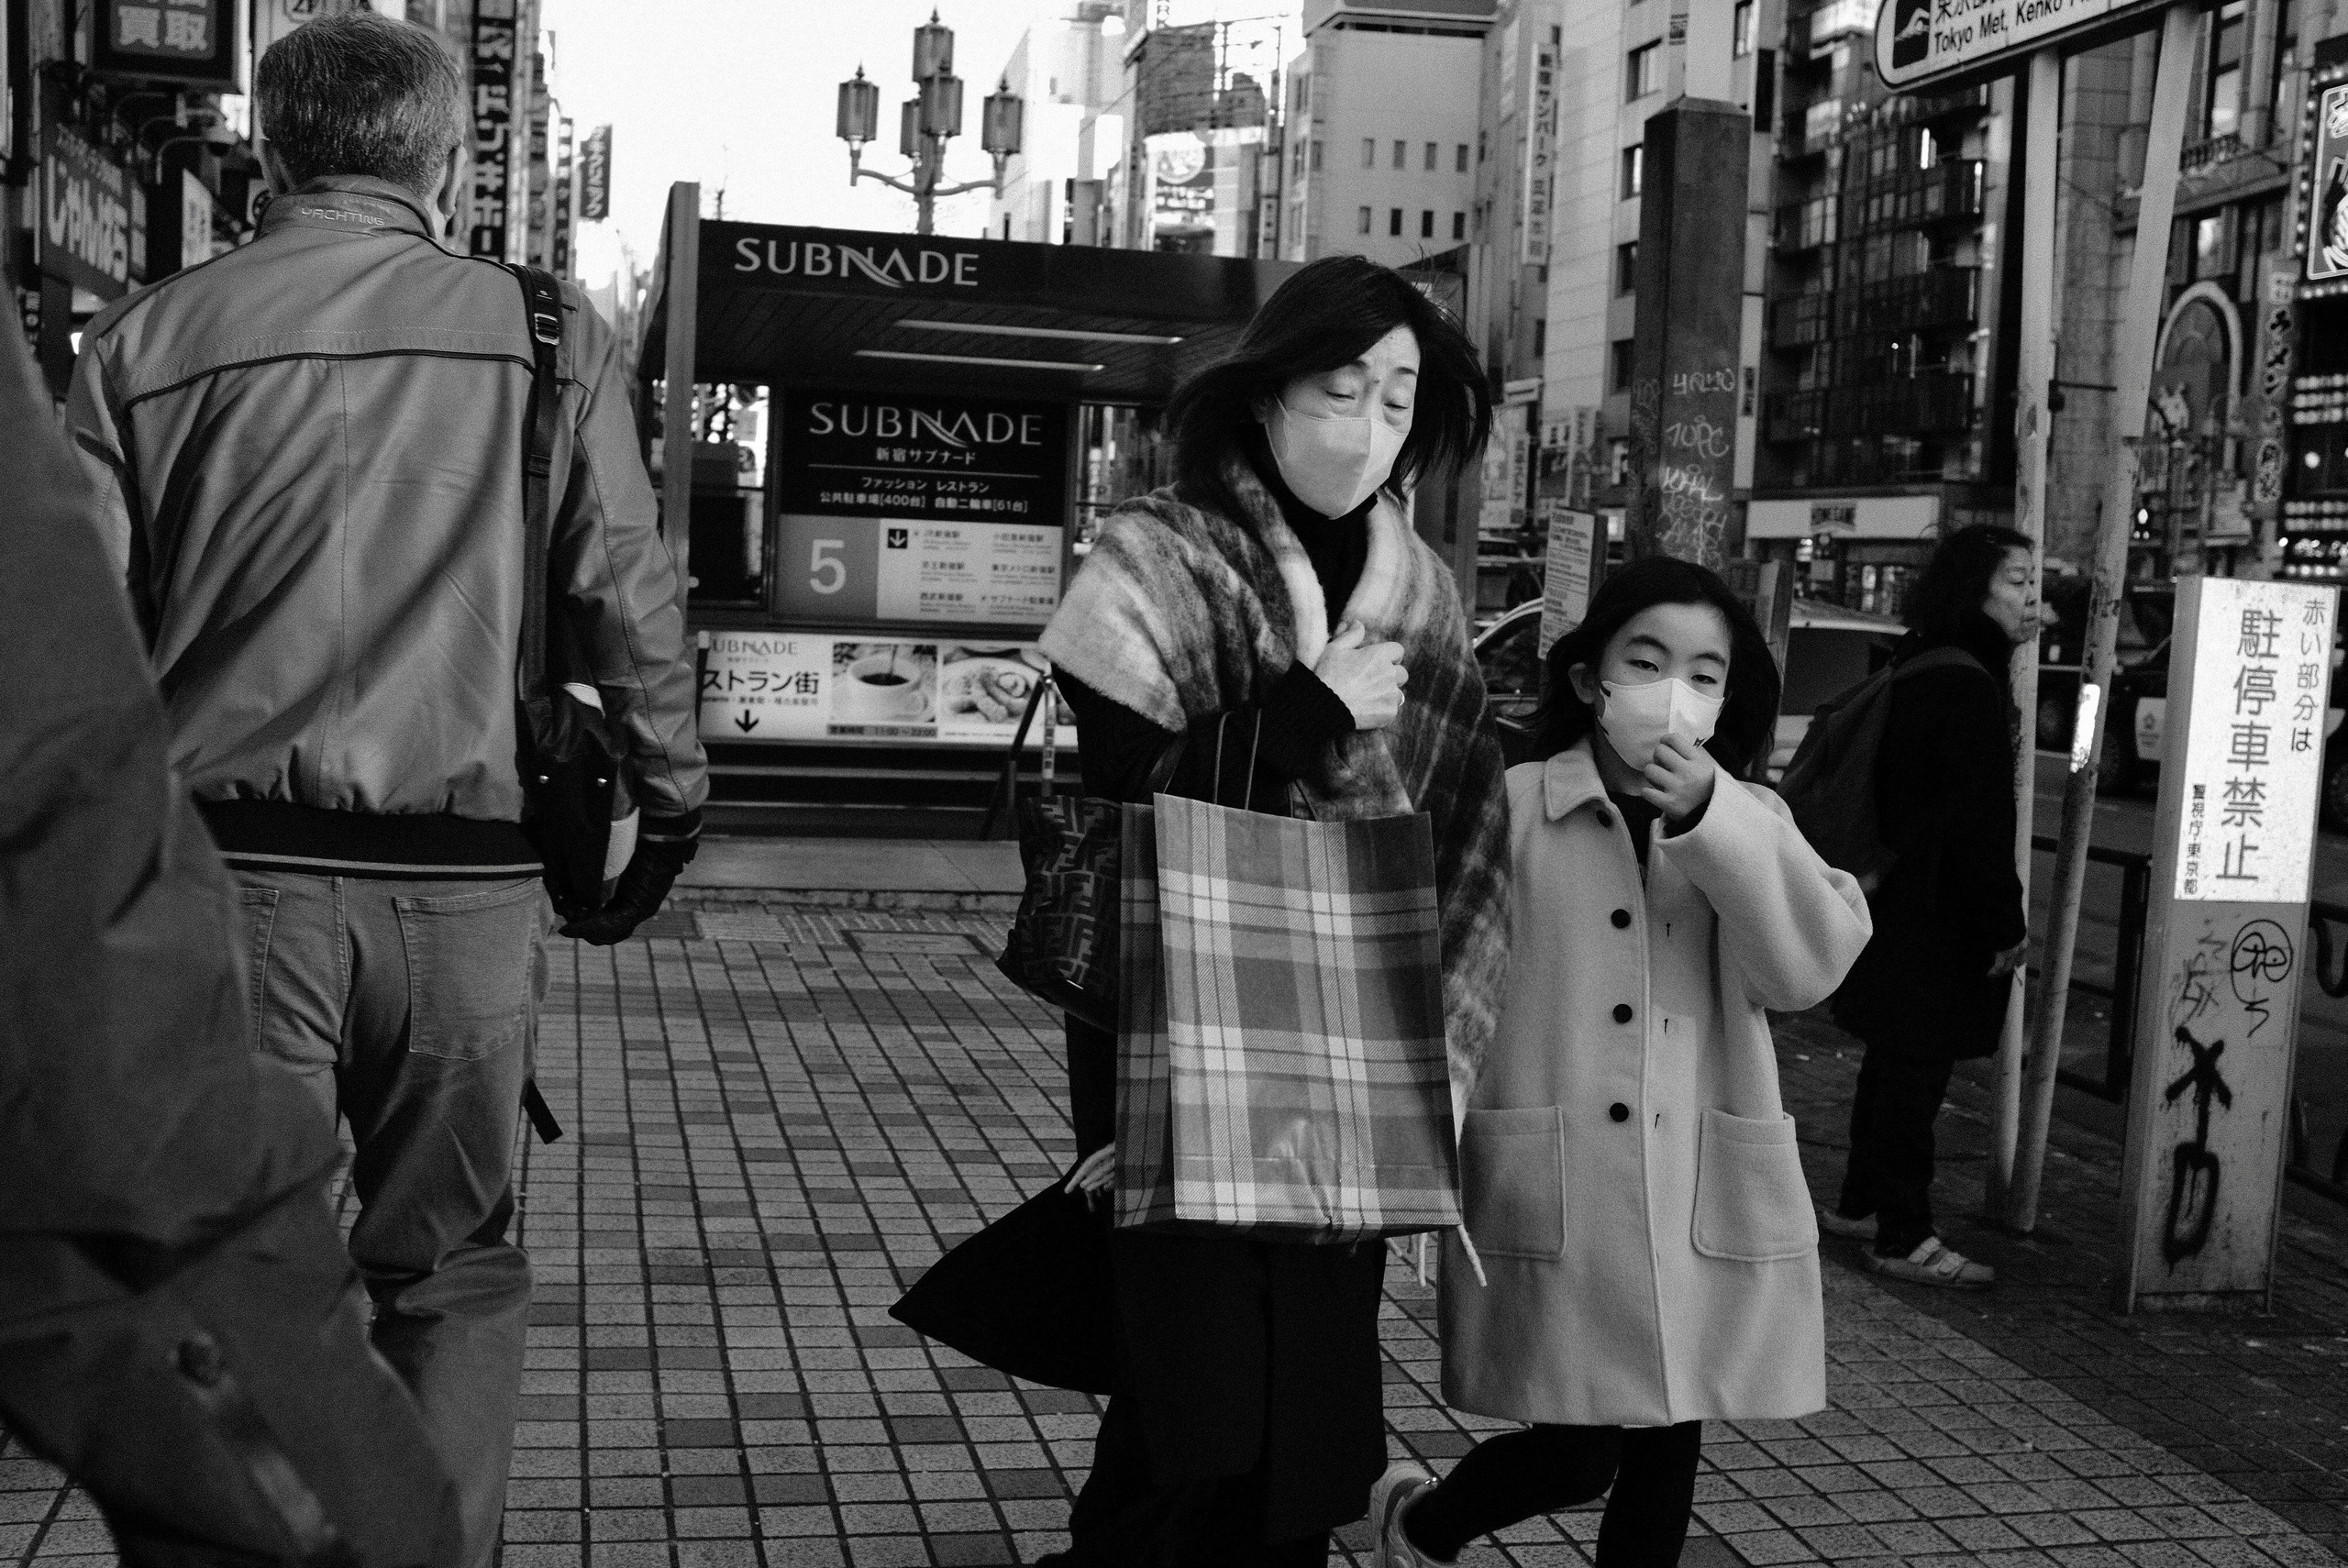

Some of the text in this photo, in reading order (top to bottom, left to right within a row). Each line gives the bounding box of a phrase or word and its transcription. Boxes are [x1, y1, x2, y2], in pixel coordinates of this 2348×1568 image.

[118, 5, 208, 50] 買取
[1933, 27, 1973, 53] Tokyo
[2017, 0, 2064, 25] Kenko
[301, 207, 386, 226] YACHTING
[735, 237, 980, 288] SUBNADE
[809, 403, 1042, 448] SUBNADE
[876, 447, 976, 465] 新宿サブナード
[861, 476, 990, 493] ファッション レストラン
[810, 539, 847, 595] 5
[710, 640, 799, 657] UBNADE
[2291, 598, 2327, 752] 赤い部分は
[2215, 609, 2283, 880] 駐停車禁止
